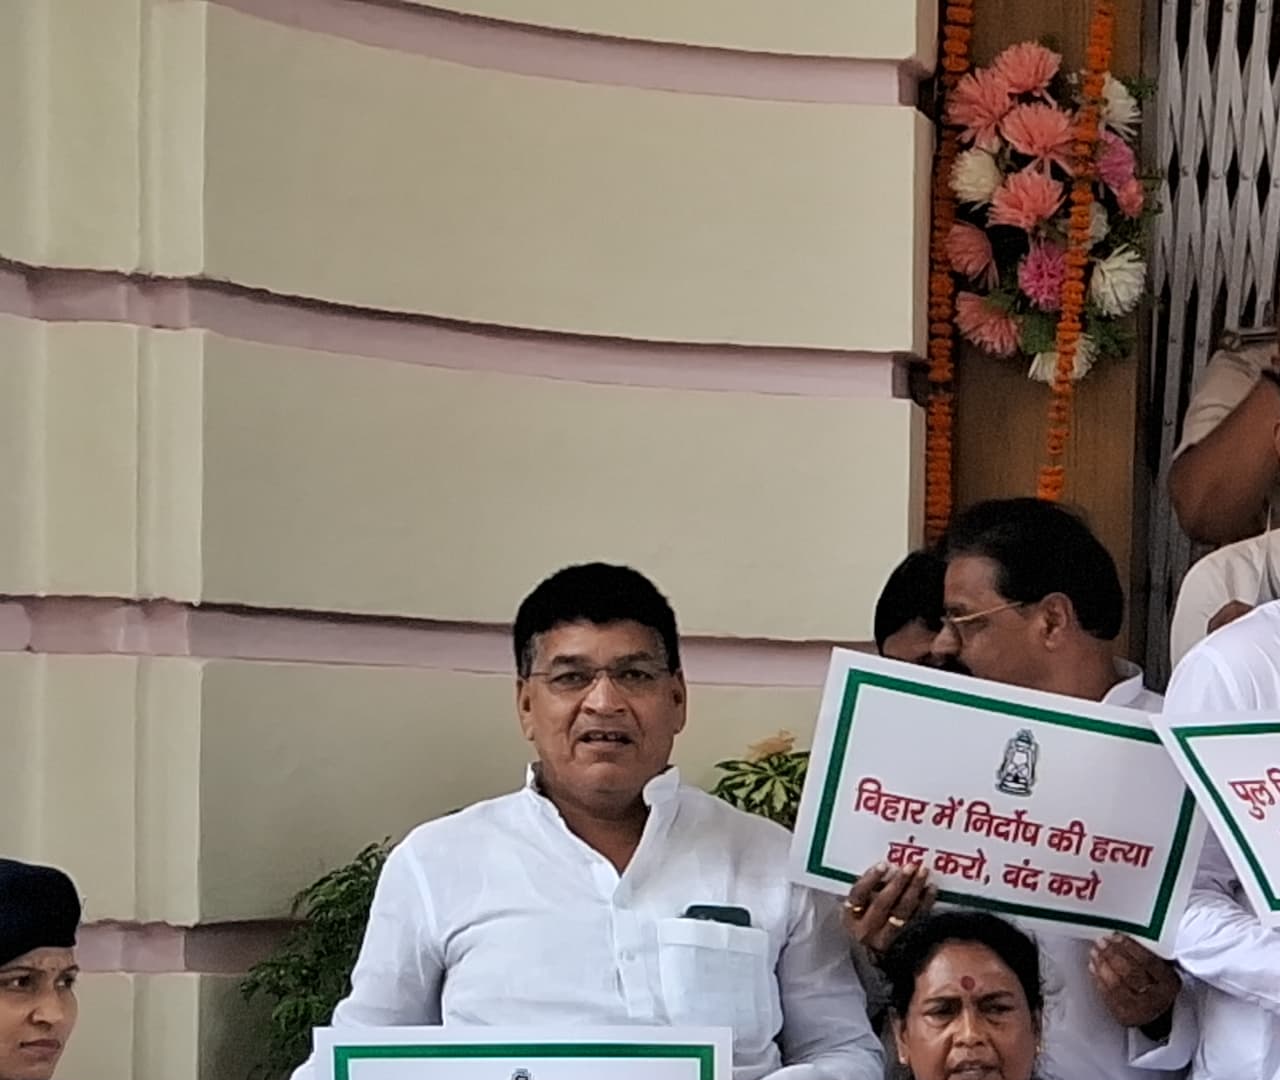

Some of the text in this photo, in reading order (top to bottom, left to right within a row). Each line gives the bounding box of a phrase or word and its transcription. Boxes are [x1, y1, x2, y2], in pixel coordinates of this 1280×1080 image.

[855, 778, 1154, 868] बिहार में निर्दोष की हत्या
[1228, 780, 1275, 820] पुल
[934, 848, 990, 885] करो,
[1003, 859, 1044, 892] बंद
[1048, 870, 1102, 901] करो
